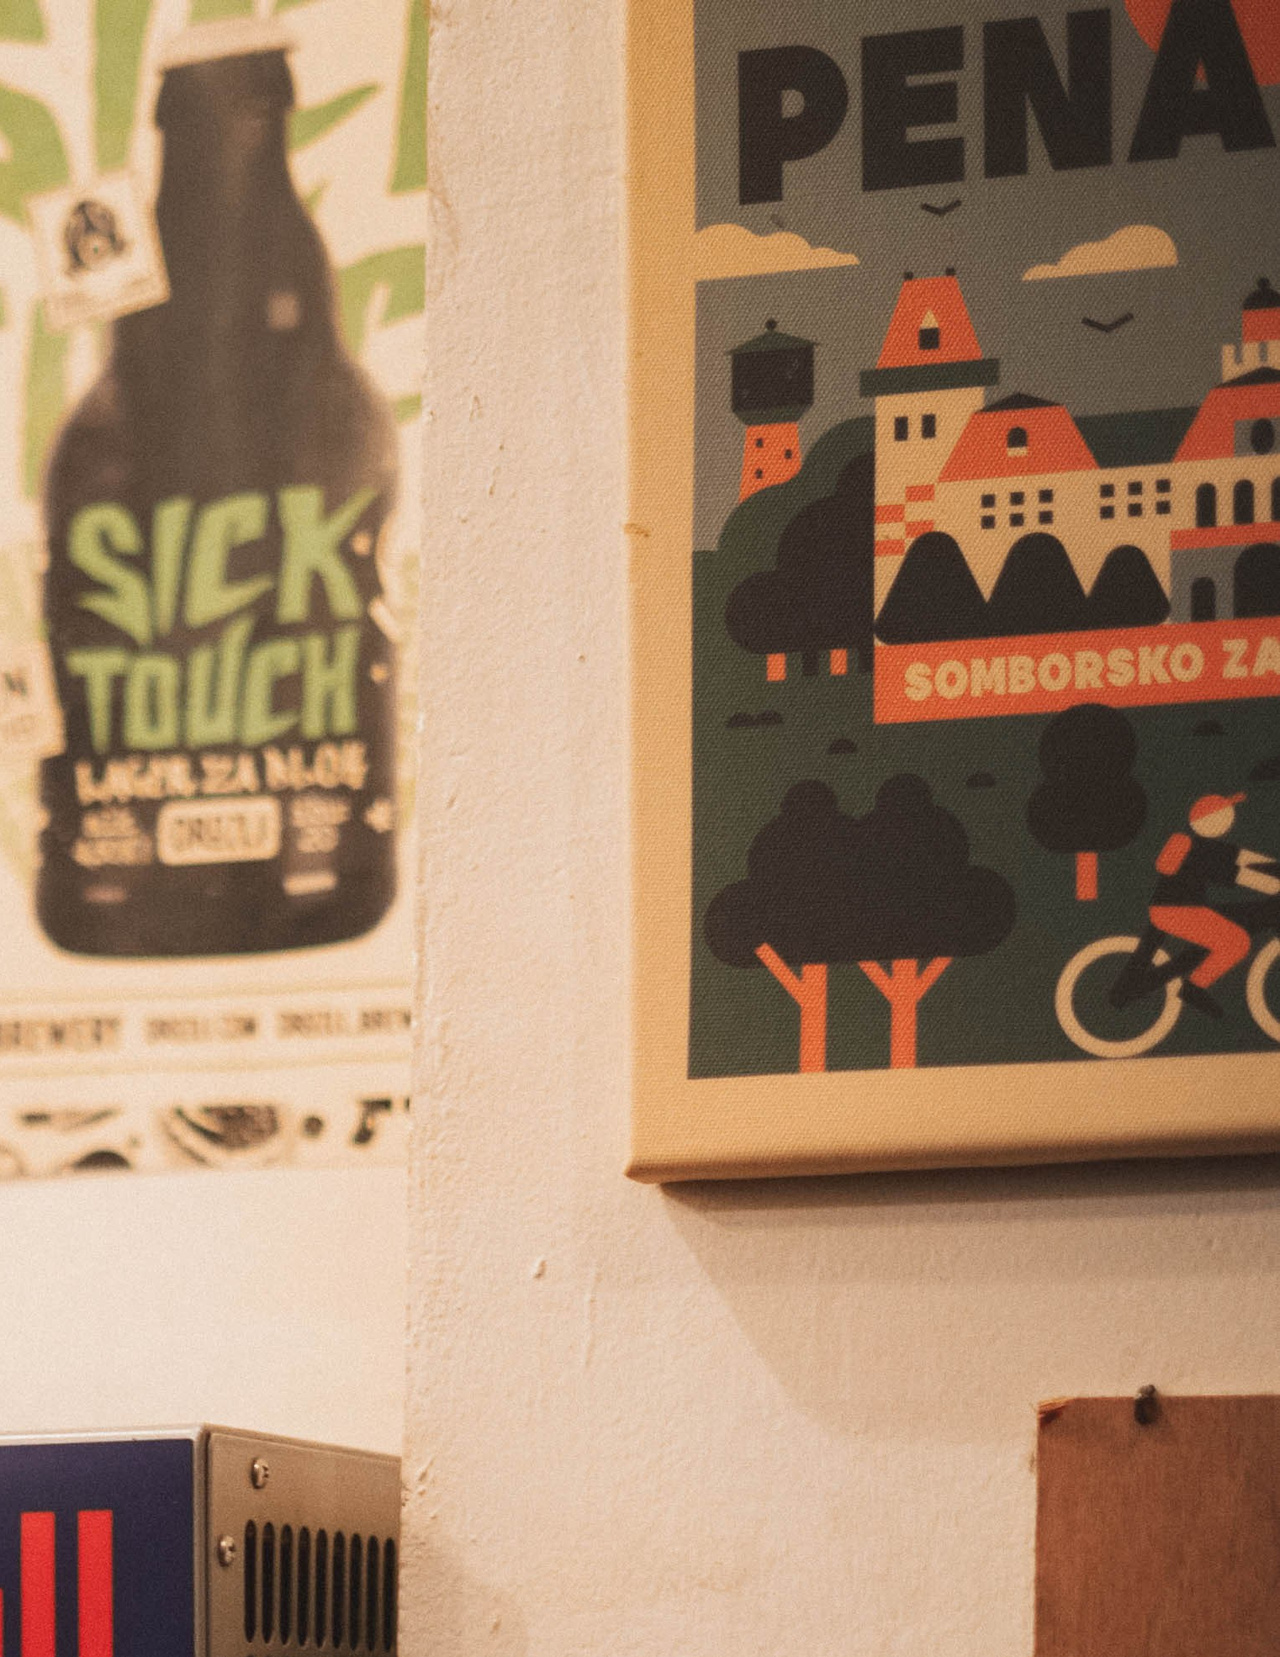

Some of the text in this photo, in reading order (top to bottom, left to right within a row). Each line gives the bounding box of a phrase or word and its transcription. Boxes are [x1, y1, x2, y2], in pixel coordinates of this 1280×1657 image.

[737, 0, 1277, 206] PENA
[66, 485, 380, 646] SICK
[66, 612, 362, 755] TOUCH
[904, 642, 1206, 701] SOMBORSKO
